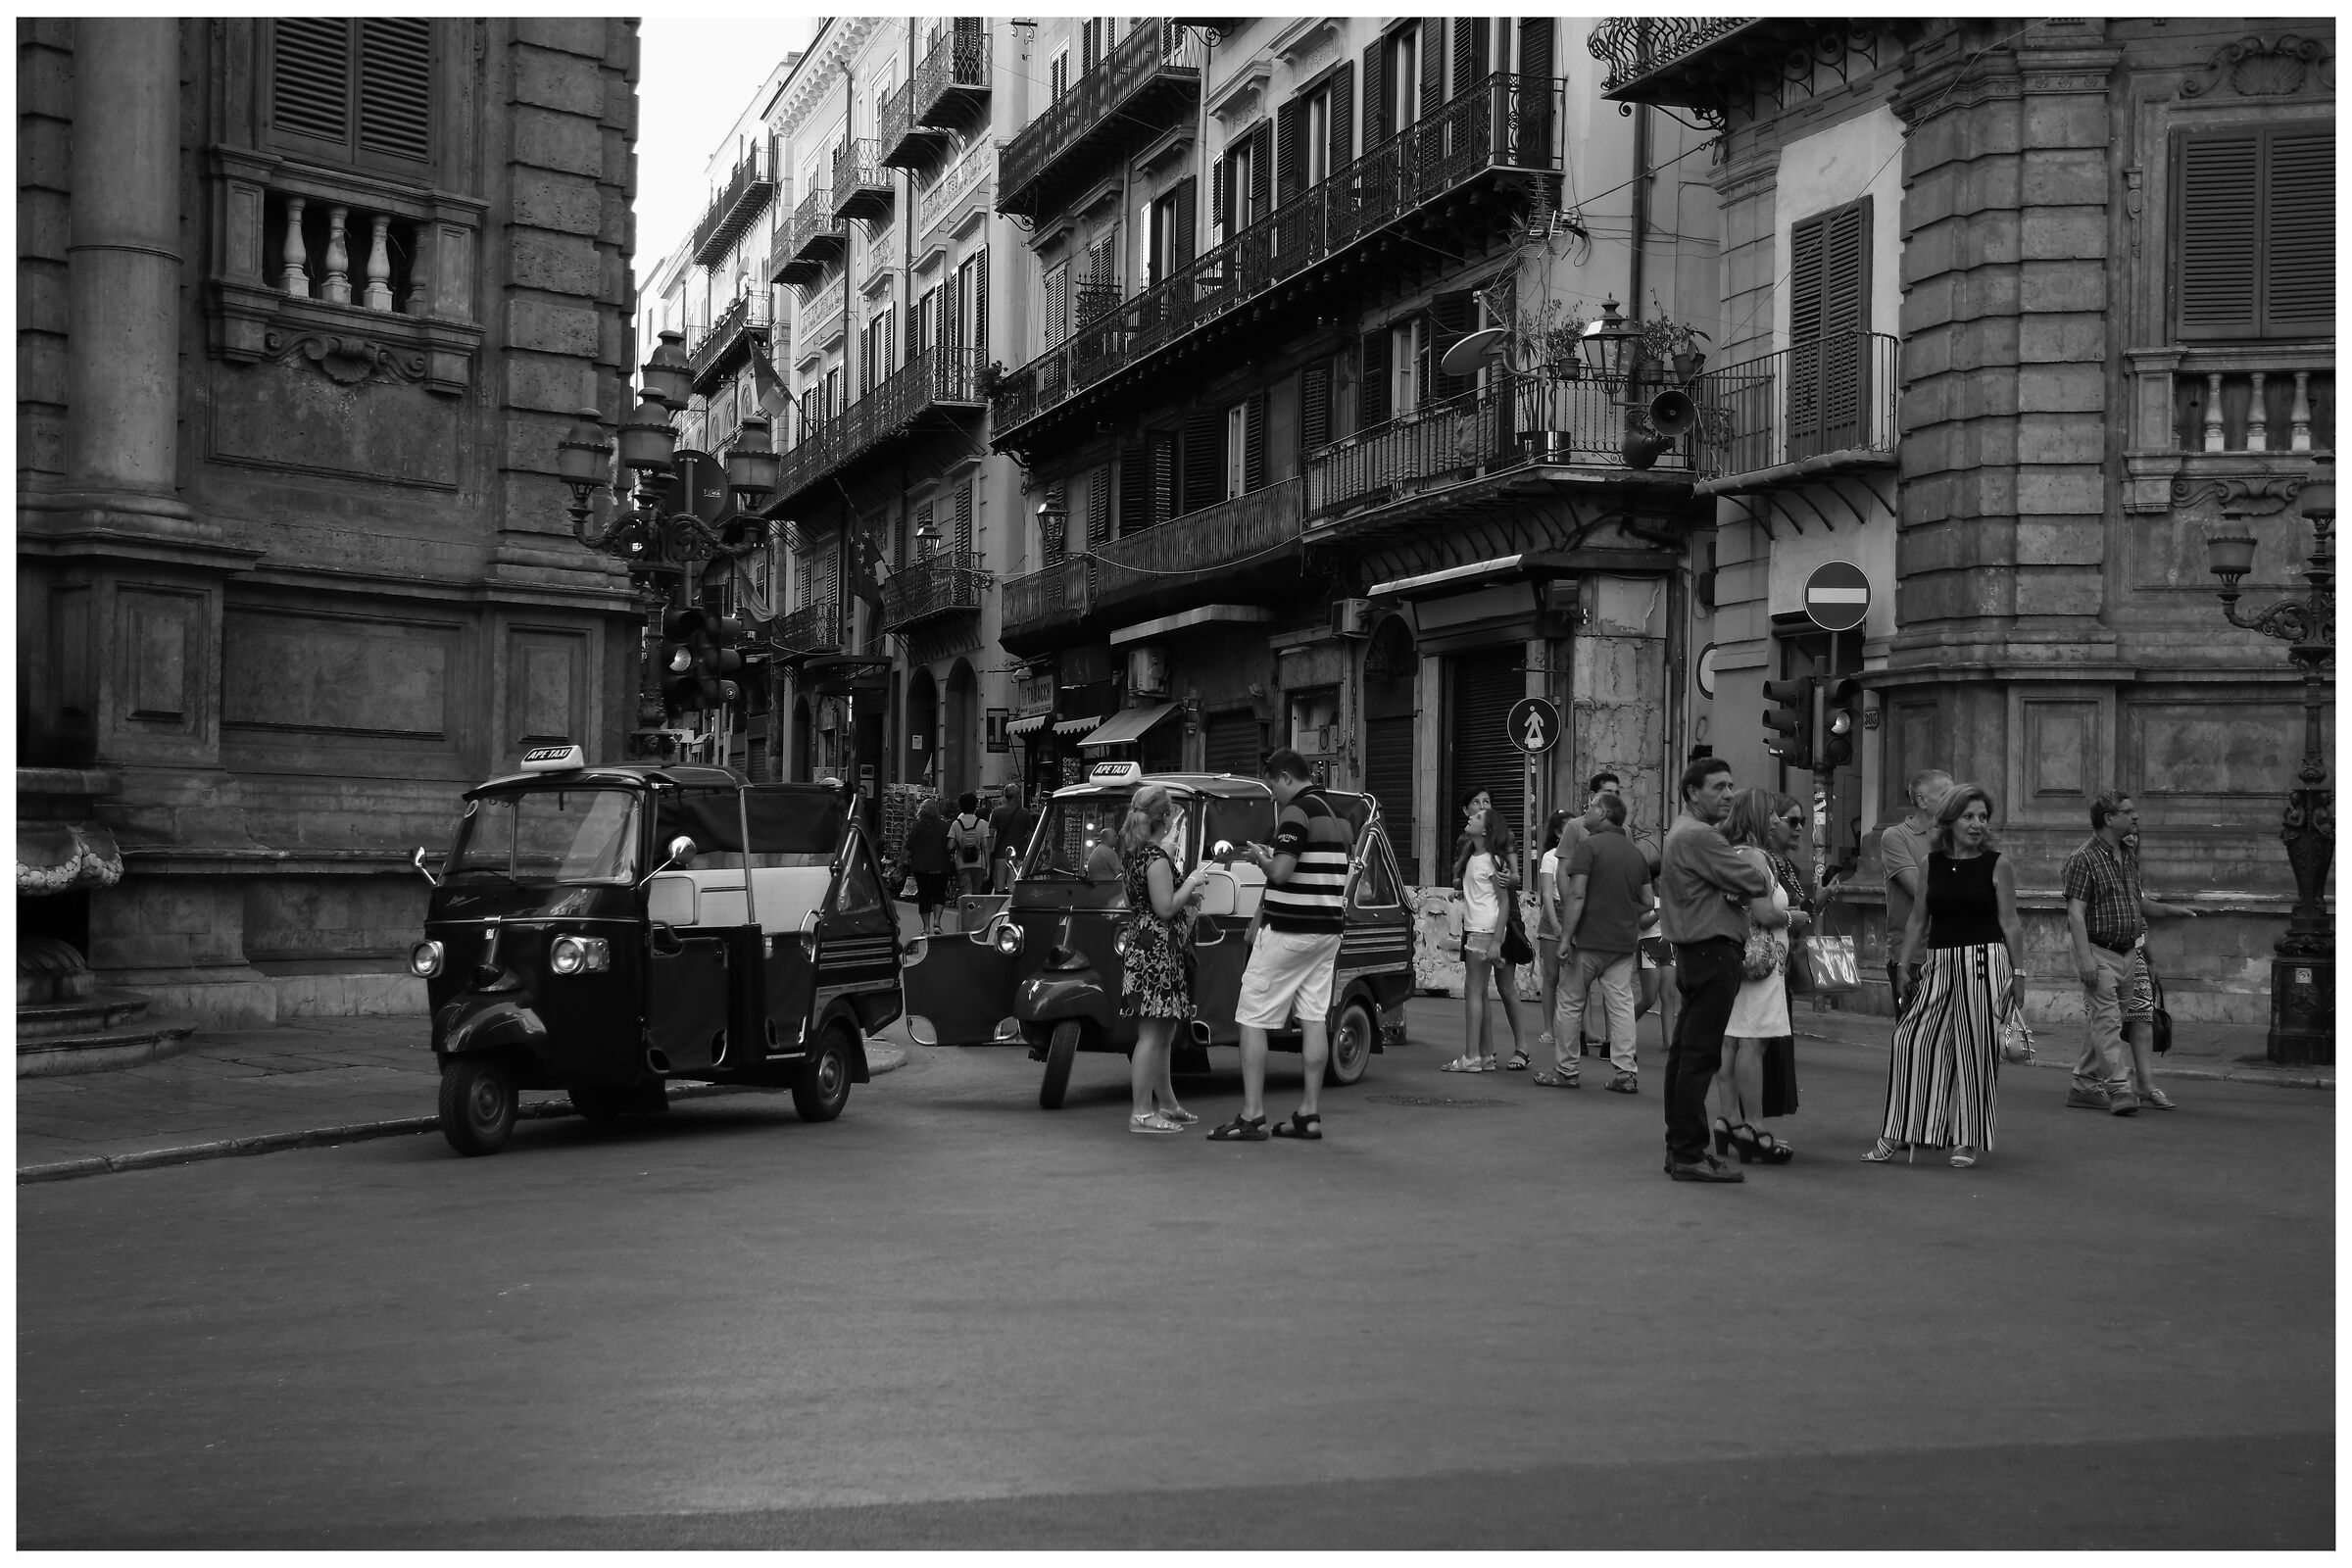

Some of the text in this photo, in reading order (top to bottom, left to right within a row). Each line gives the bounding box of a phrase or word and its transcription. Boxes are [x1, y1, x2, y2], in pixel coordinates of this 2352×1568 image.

[526, 748, 571, 760] APE TAXI
[1095, 764, 1130, 774] APE TAXI
